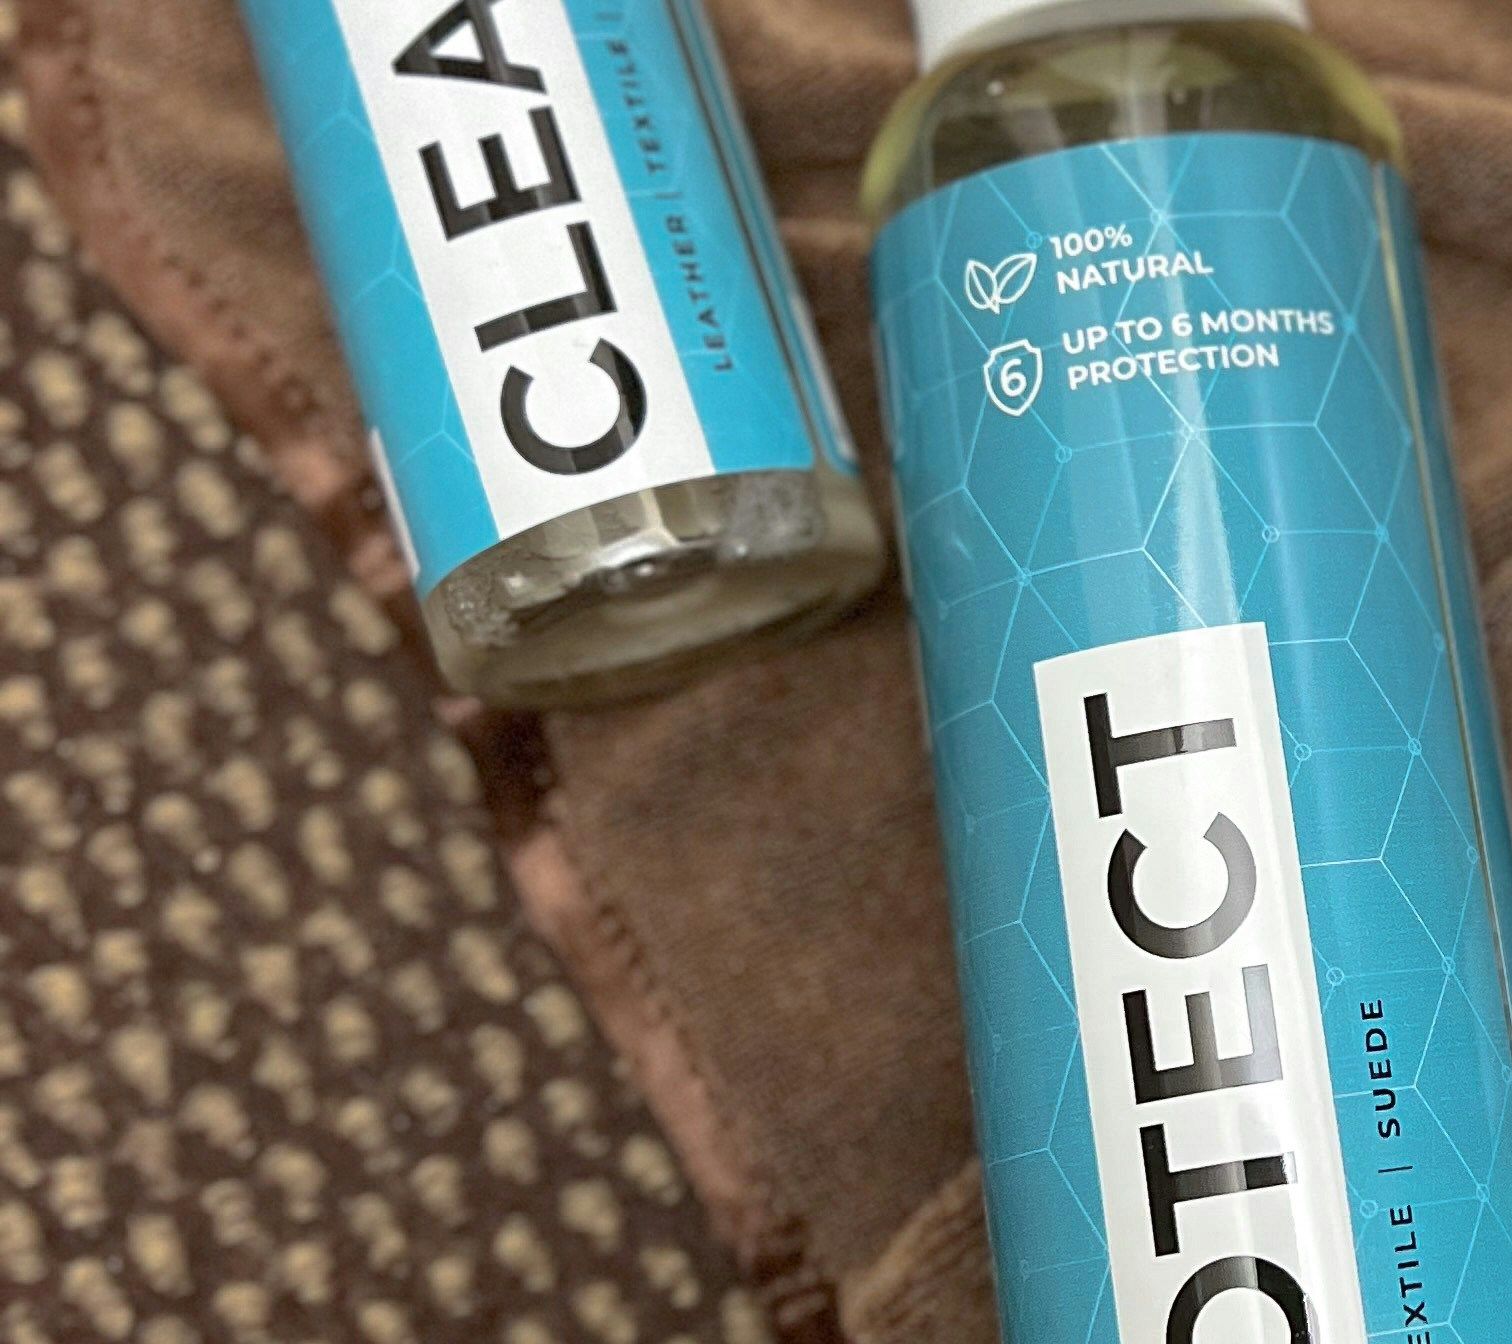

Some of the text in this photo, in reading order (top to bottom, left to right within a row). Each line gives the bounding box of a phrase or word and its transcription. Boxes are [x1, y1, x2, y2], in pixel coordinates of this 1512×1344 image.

[607, 38, 668, 177] TEXTILE
[1050, 224, 1133, 259] 100%
[666, 215, 734, 373] LEATHER
[1056, 251, 1214, 295] NATURAL
[1062, 307, 1335, 354] UP TO 6 MONTHS
[1067, 343, 1280, 391] PROTECTION
[1360, 999, 1400, 1140] SUEDE
